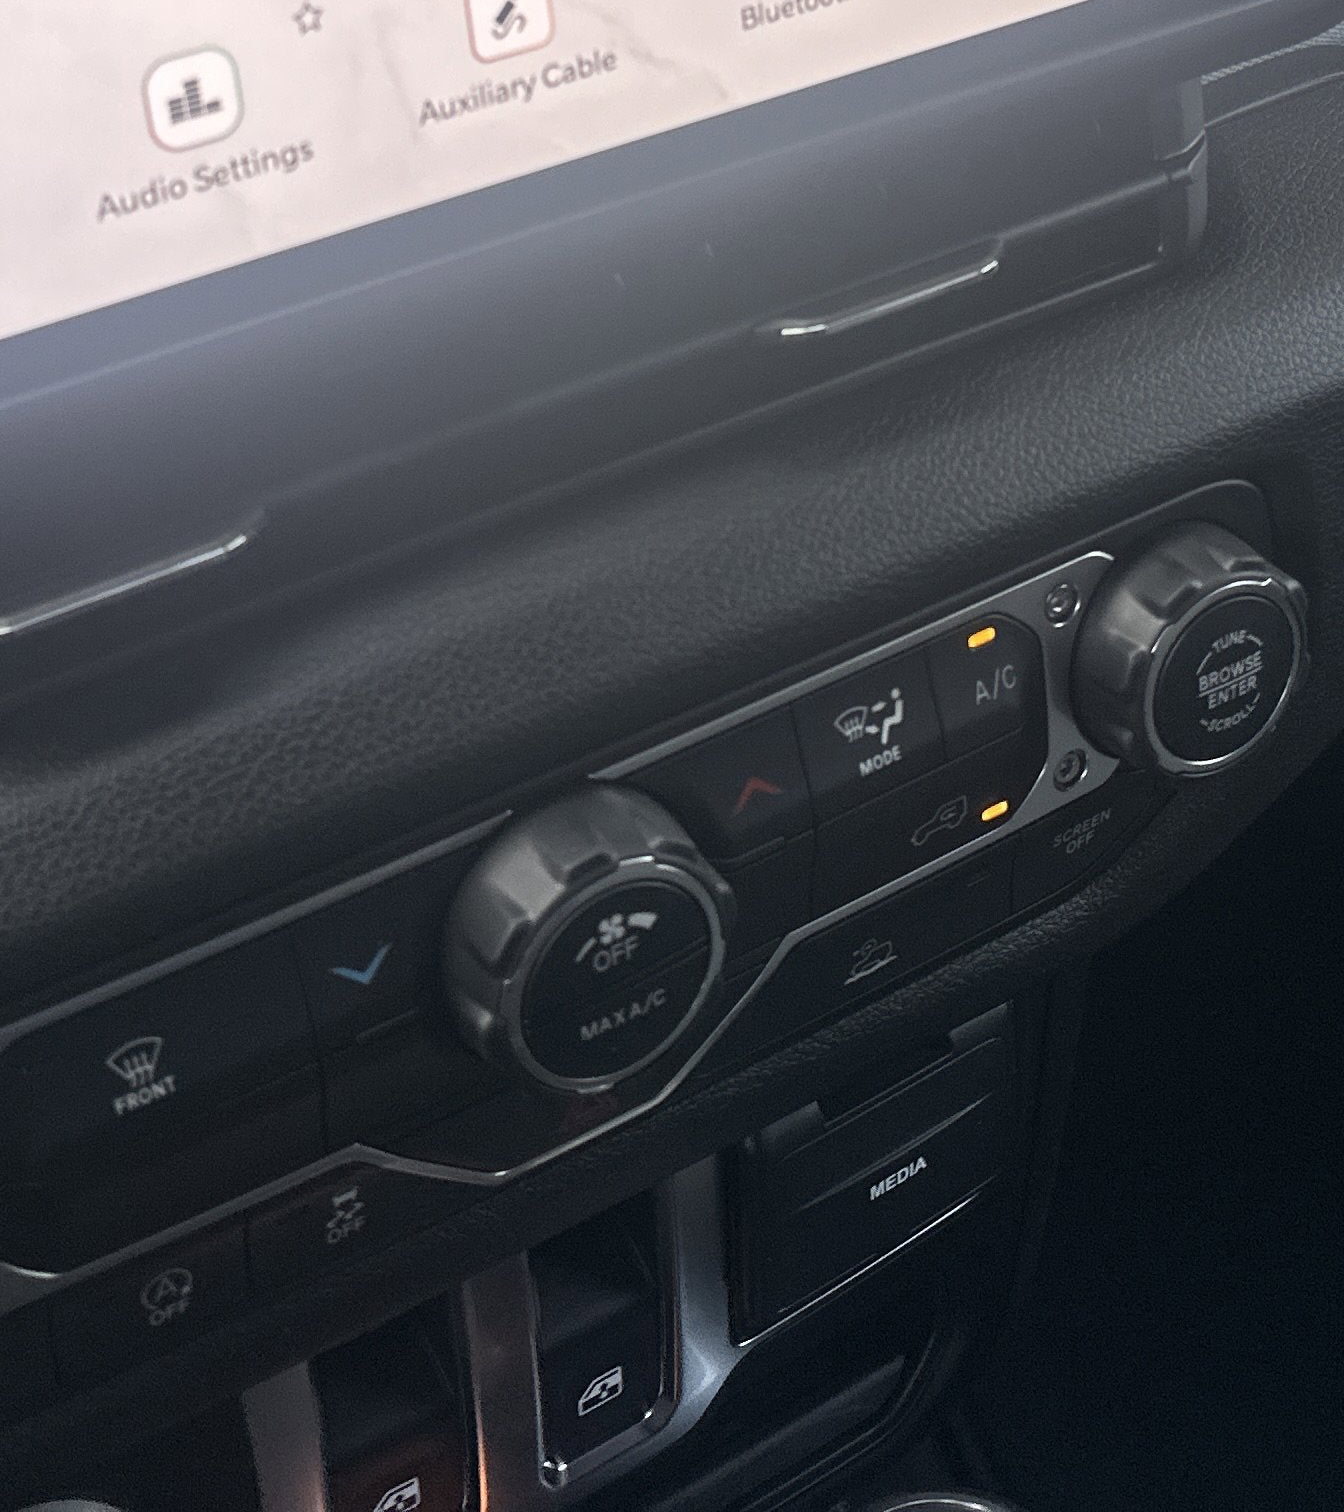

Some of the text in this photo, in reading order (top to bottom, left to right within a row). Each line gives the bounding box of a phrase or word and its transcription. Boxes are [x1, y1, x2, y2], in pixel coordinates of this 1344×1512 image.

[417, 49, 619, 128] Auxiliary Cable
[95, 139, 316, 224] Audio Settings
[1212, 629, 1248, 653] TUNE
[973, 663, 1018, 706] A/C
[1198, 649, 1263, 692] BROWSE
[1207, 674, 1258, 710] ENTER
[859, 744, 903, 778] MODE
[1053, 806, 1112, 848] SCREEN
[1065, 829, 1096, 854] OFF
[591, 937, 640, 974] OFF
[580, 988, 667, 1041] MAX A/C
[113, 1075, 177, 1116] FRONT
[869, 1156, 927, 1201] MEDIA
